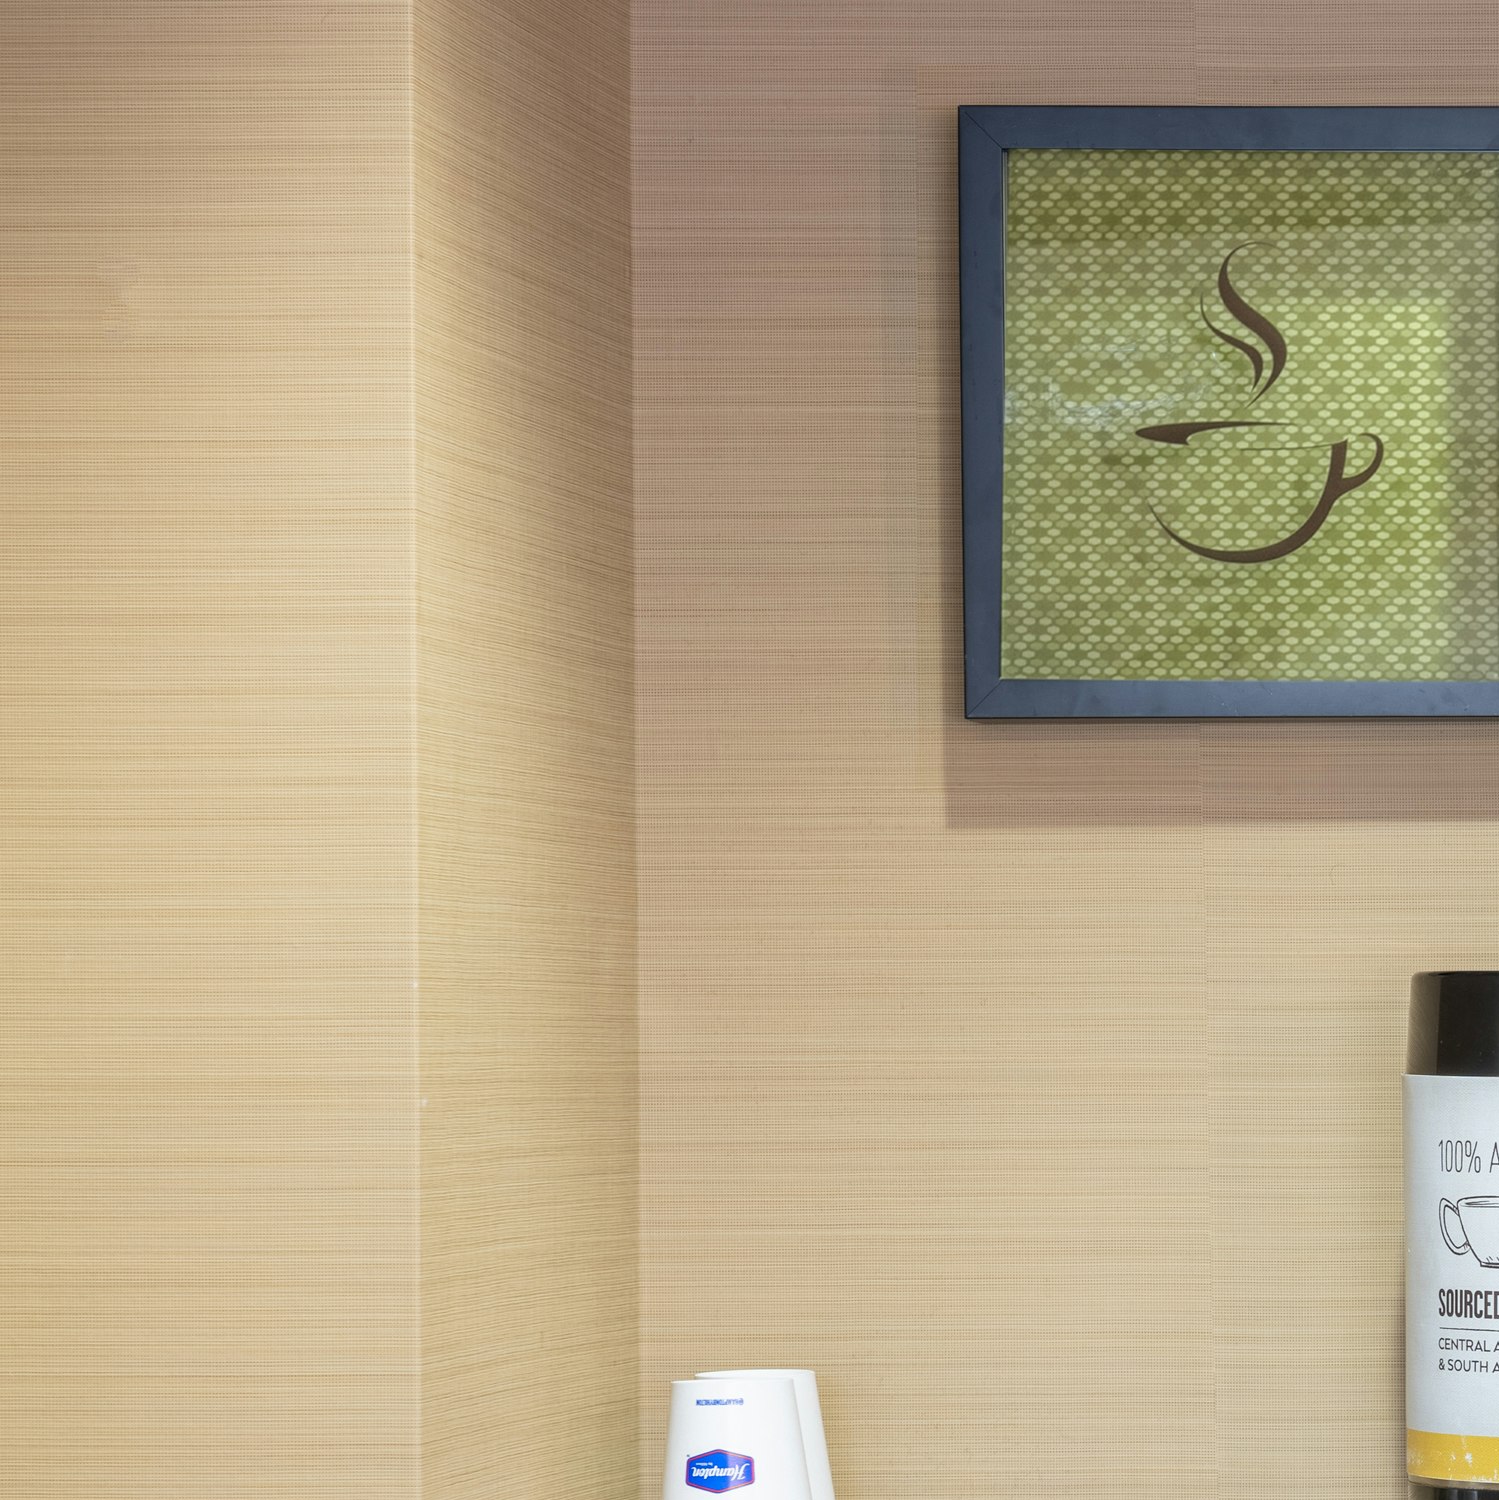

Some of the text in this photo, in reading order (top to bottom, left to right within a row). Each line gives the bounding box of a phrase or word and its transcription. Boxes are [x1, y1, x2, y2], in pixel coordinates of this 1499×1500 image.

[1438, 1140, 1481, 1174] 100%
[1438, 1337, 1491, 1354] CENTRAL
[1438, 1358, 1446, 1371] &
[1447, 1359, 1489, 1374] SOUTH
[691, 1463, 750, 1481] Hampton
